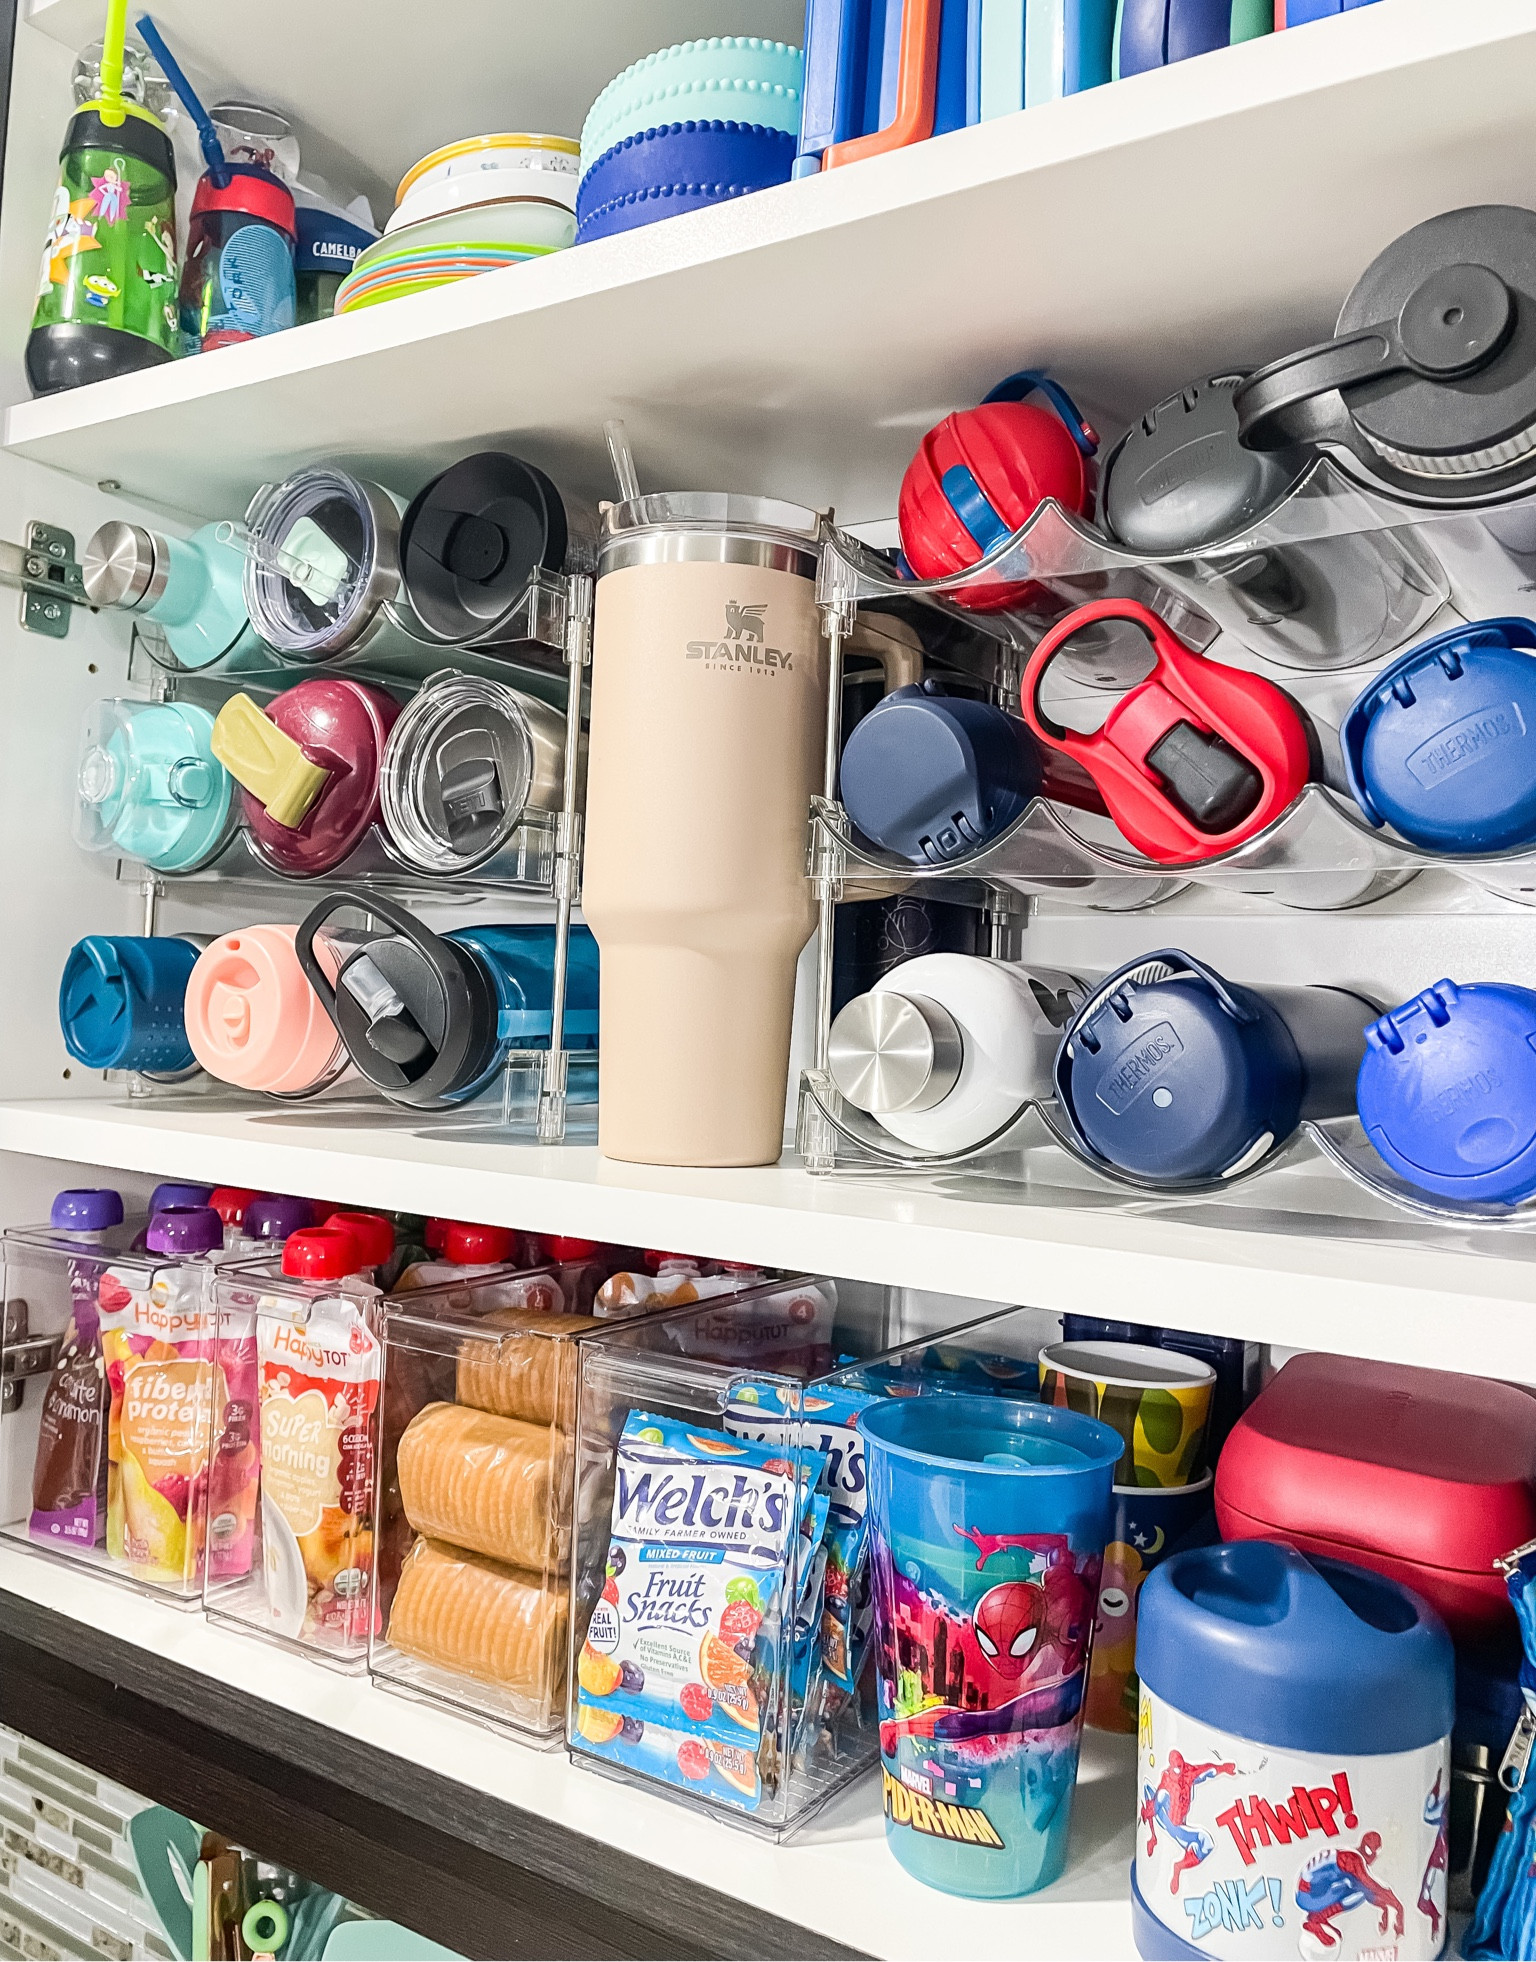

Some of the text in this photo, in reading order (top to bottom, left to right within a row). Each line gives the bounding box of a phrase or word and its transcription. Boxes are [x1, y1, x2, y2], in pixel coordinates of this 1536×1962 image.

[312, 241, 362, 258] CAMELBA
[686, 641, 792, 669] STANLEY
[706, 663, 742, 672] SINCE
[1422, 714, 1511, 774] THERMOS
[1109, 1036, 1171, 1098] THERMOS
[617, 1467, 787, 1532] Welch's
[664, 1529, 705, 1538] FARMER
[710, 1531, 747, 1540] OWNED
[646, 1548, 718, 1562] MIXED FRUIT
[645, 1571, 706, 1598] Fruit
[593, 1612, 612, 1624] REAL
[623, 1592, 713, 1628] Snacks
[589, 1626, 617, 1639] FRUIT!
[882, 1767, 1004, 1848] PIDER-MAN
[1216, 1772, 1358, 1867] THWIP!
[1184, 1876, 1284, 1940] ZONK!
